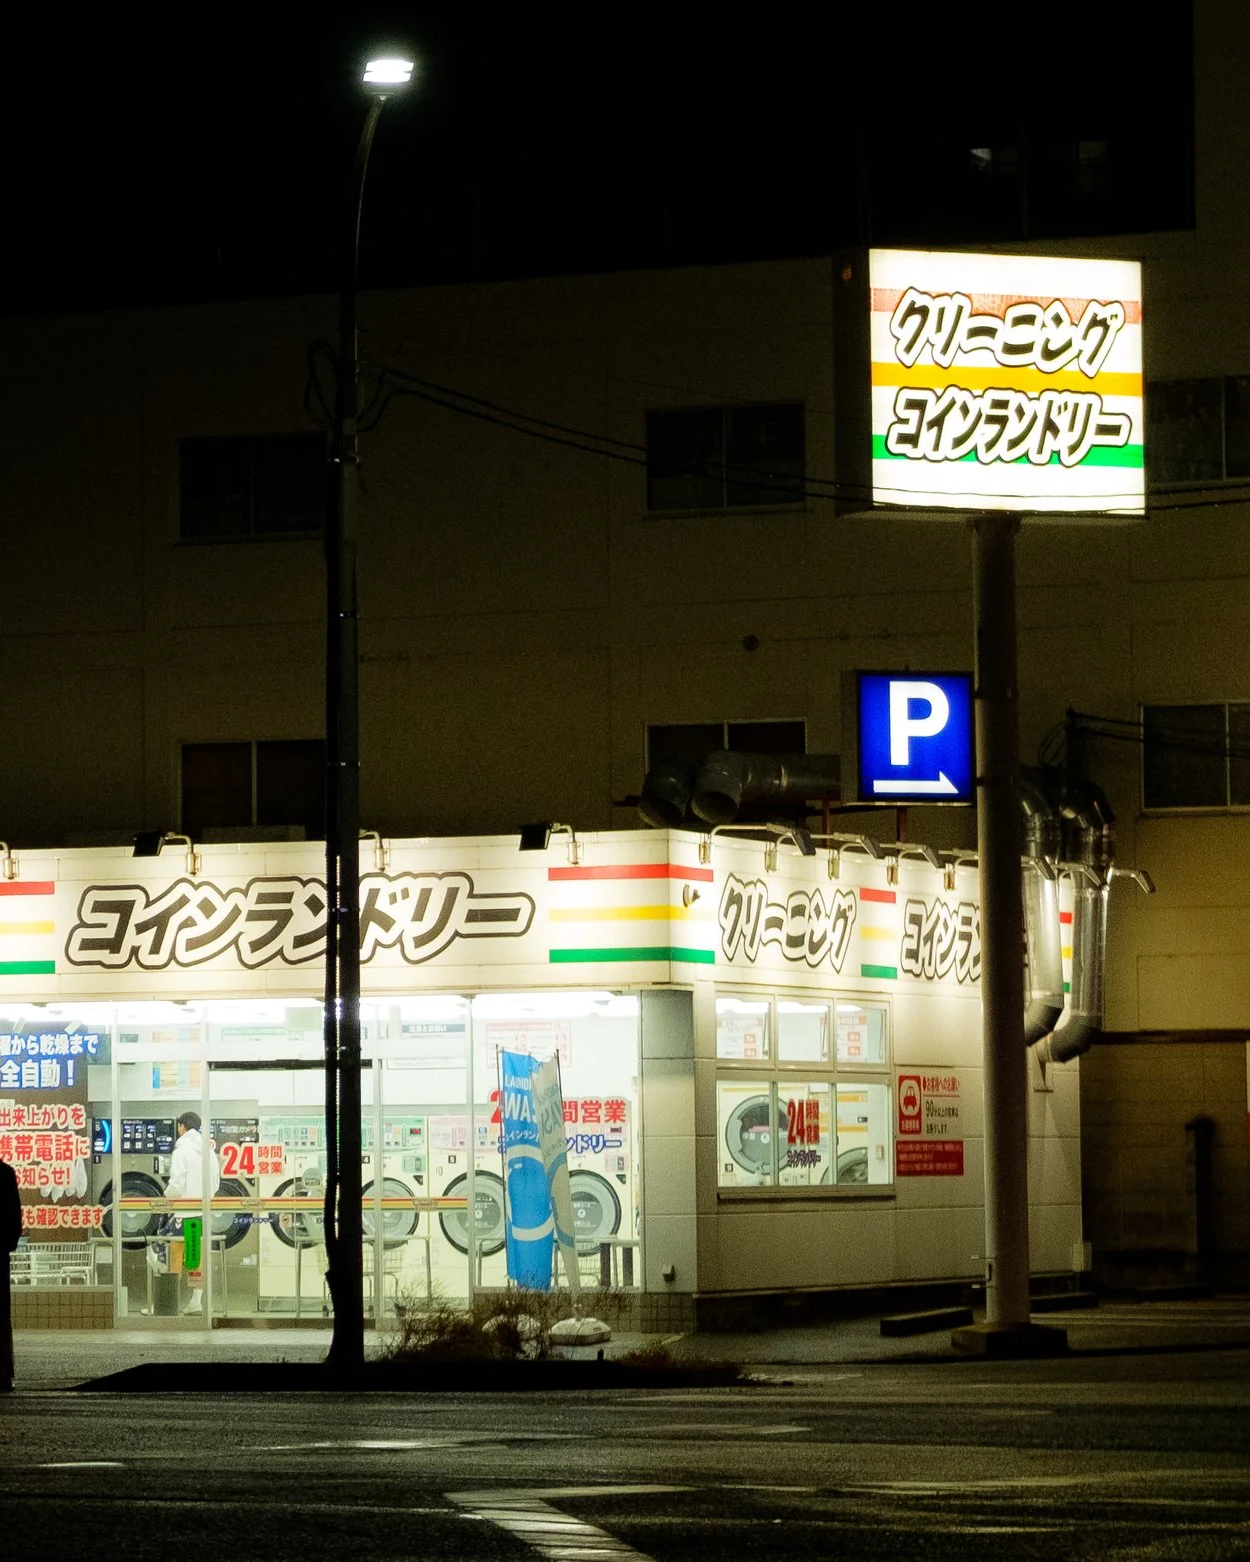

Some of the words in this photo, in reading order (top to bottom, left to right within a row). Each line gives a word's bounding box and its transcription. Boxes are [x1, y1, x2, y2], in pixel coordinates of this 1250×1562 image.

[891, 287, 1123, 377] クリーニング
[886, 385, 1132, 467] コインランドリー
[890, 680, 949, 765] P
[719, 873, 857, 974] クリーニング
[223, 1146, 255, 1175] 24
[258, 1146, 282, 1158] 時間
[787, 1098, 805, 1144] 24
[258, 1161, 282, 1175] 営業
